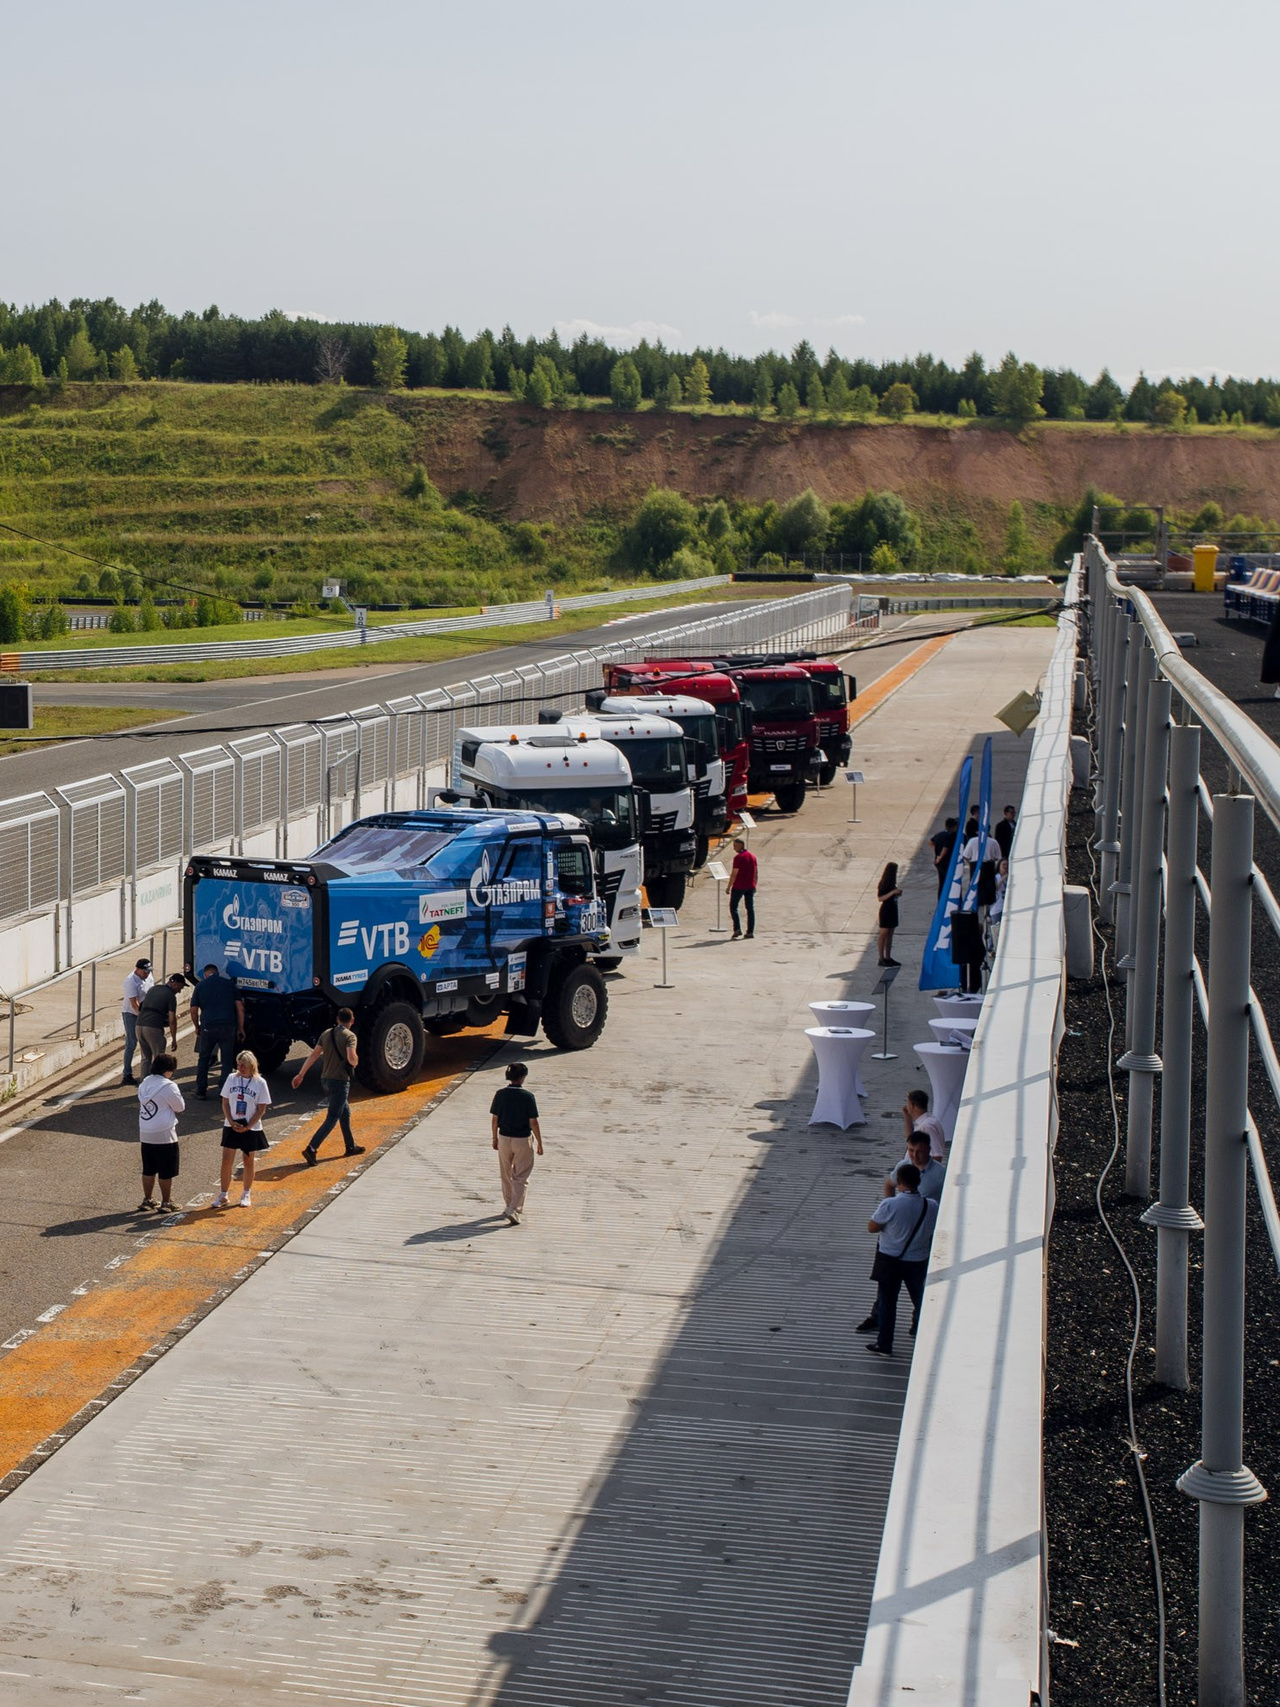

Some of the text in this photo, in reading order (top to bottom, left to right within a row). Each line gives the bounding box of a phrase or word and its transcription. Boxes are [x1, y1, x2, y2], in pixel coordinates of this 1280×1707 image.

[213, 867, 238, 878] KAMAZ
[263, 871, 289, 882] KAMAZ
[489, 879, 541, 906] ГАЗПРОМ
[429, 906, 465, 918] TATNEFT
[240, 917, 283, 934] ГАЗПРОМ
[581, 913, 596, 932] 300
[360, 921, 410, 960] VTB
[242, 947, 283, 973] VTB
